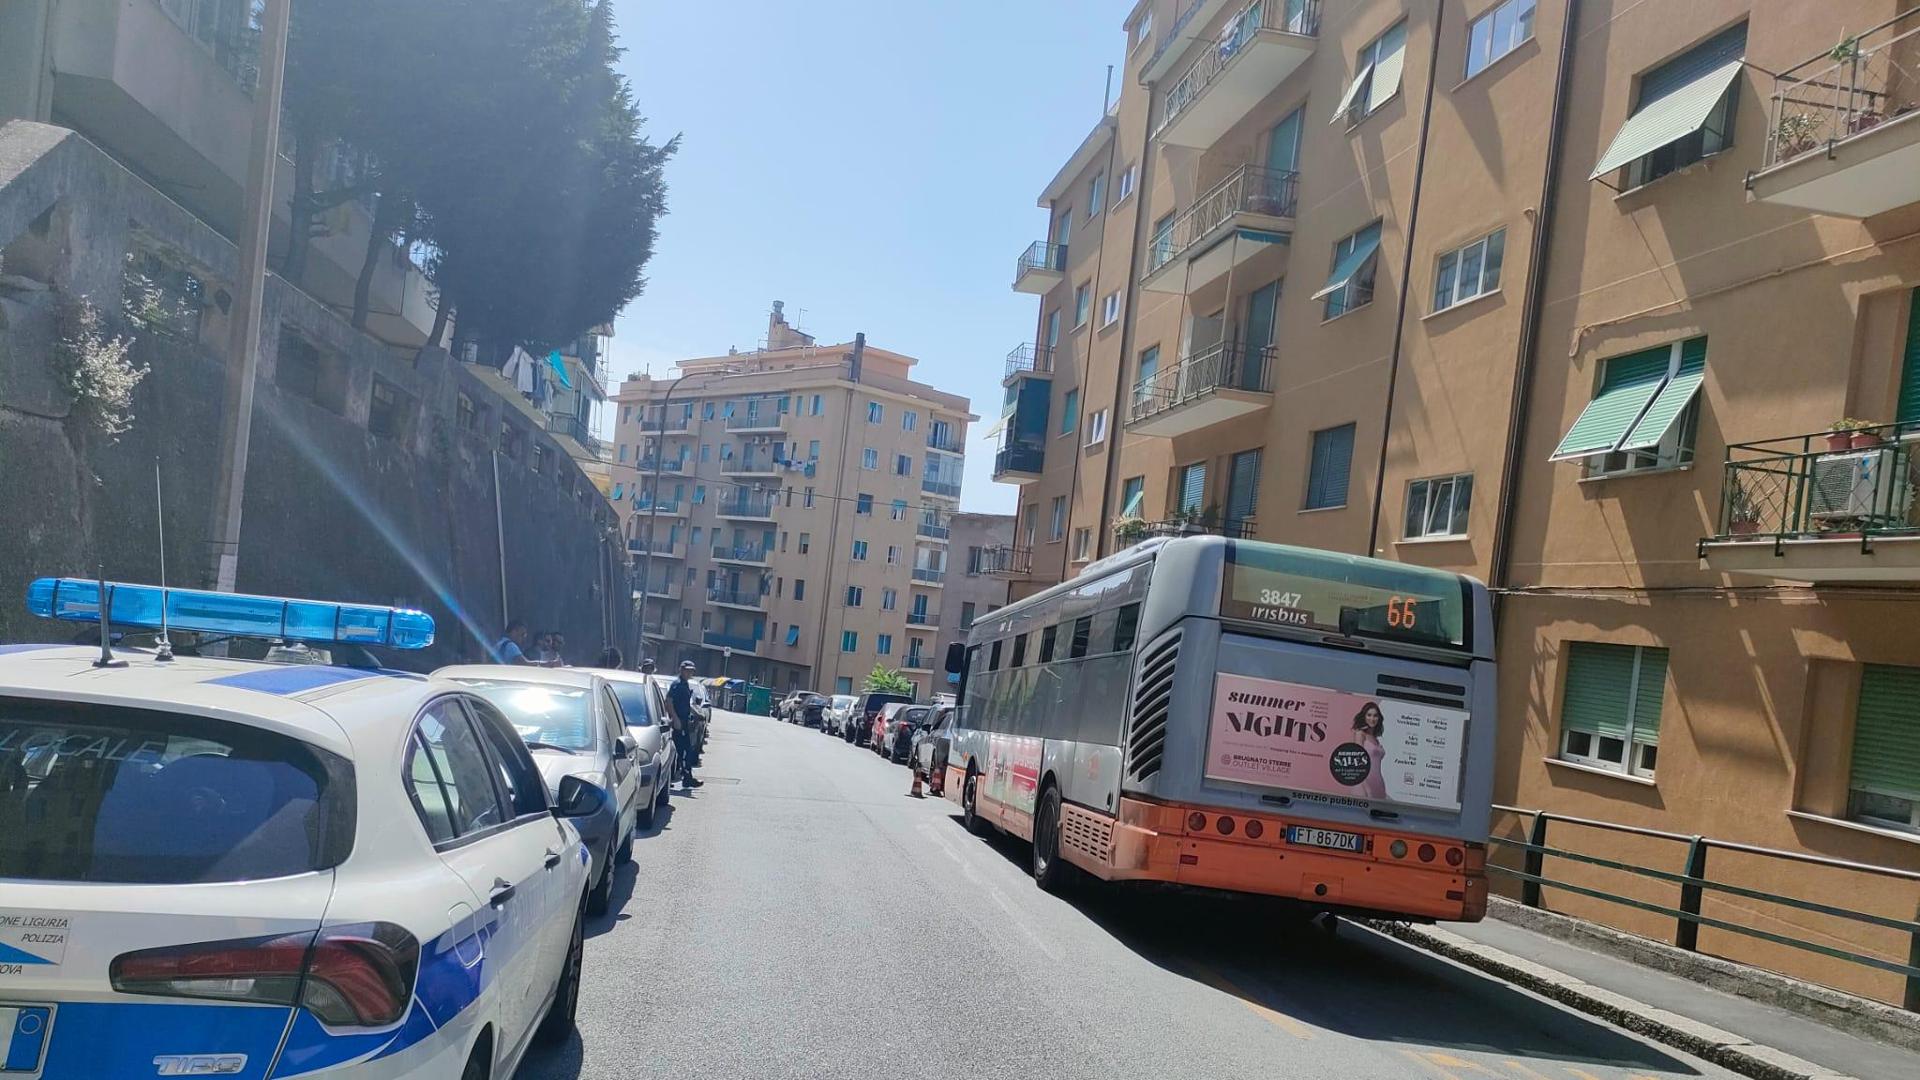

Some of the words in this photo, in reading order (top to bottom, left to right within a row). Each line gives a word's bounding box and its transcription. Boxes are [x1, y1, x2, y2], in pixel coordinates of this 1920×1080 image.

[1260, 588, 1301, 609] 3847
[1387, 594, 1416, 629] 66
[1227, 691, 1306, 712] summer
[1225, 711, 1328, 742] NIGHTS
[0, 729, 167, 763] LOCALE
[1292, 791, 1328, 802] servizio
[1330, 796, 1369, 808] pubblico
[1297, 828, 1312, 841] FT
[1317, 831, 1355, 849] 867DK
[22, 917, 68, 928] LIGURIA
[21, 933, 64, 943] POLIZIA
